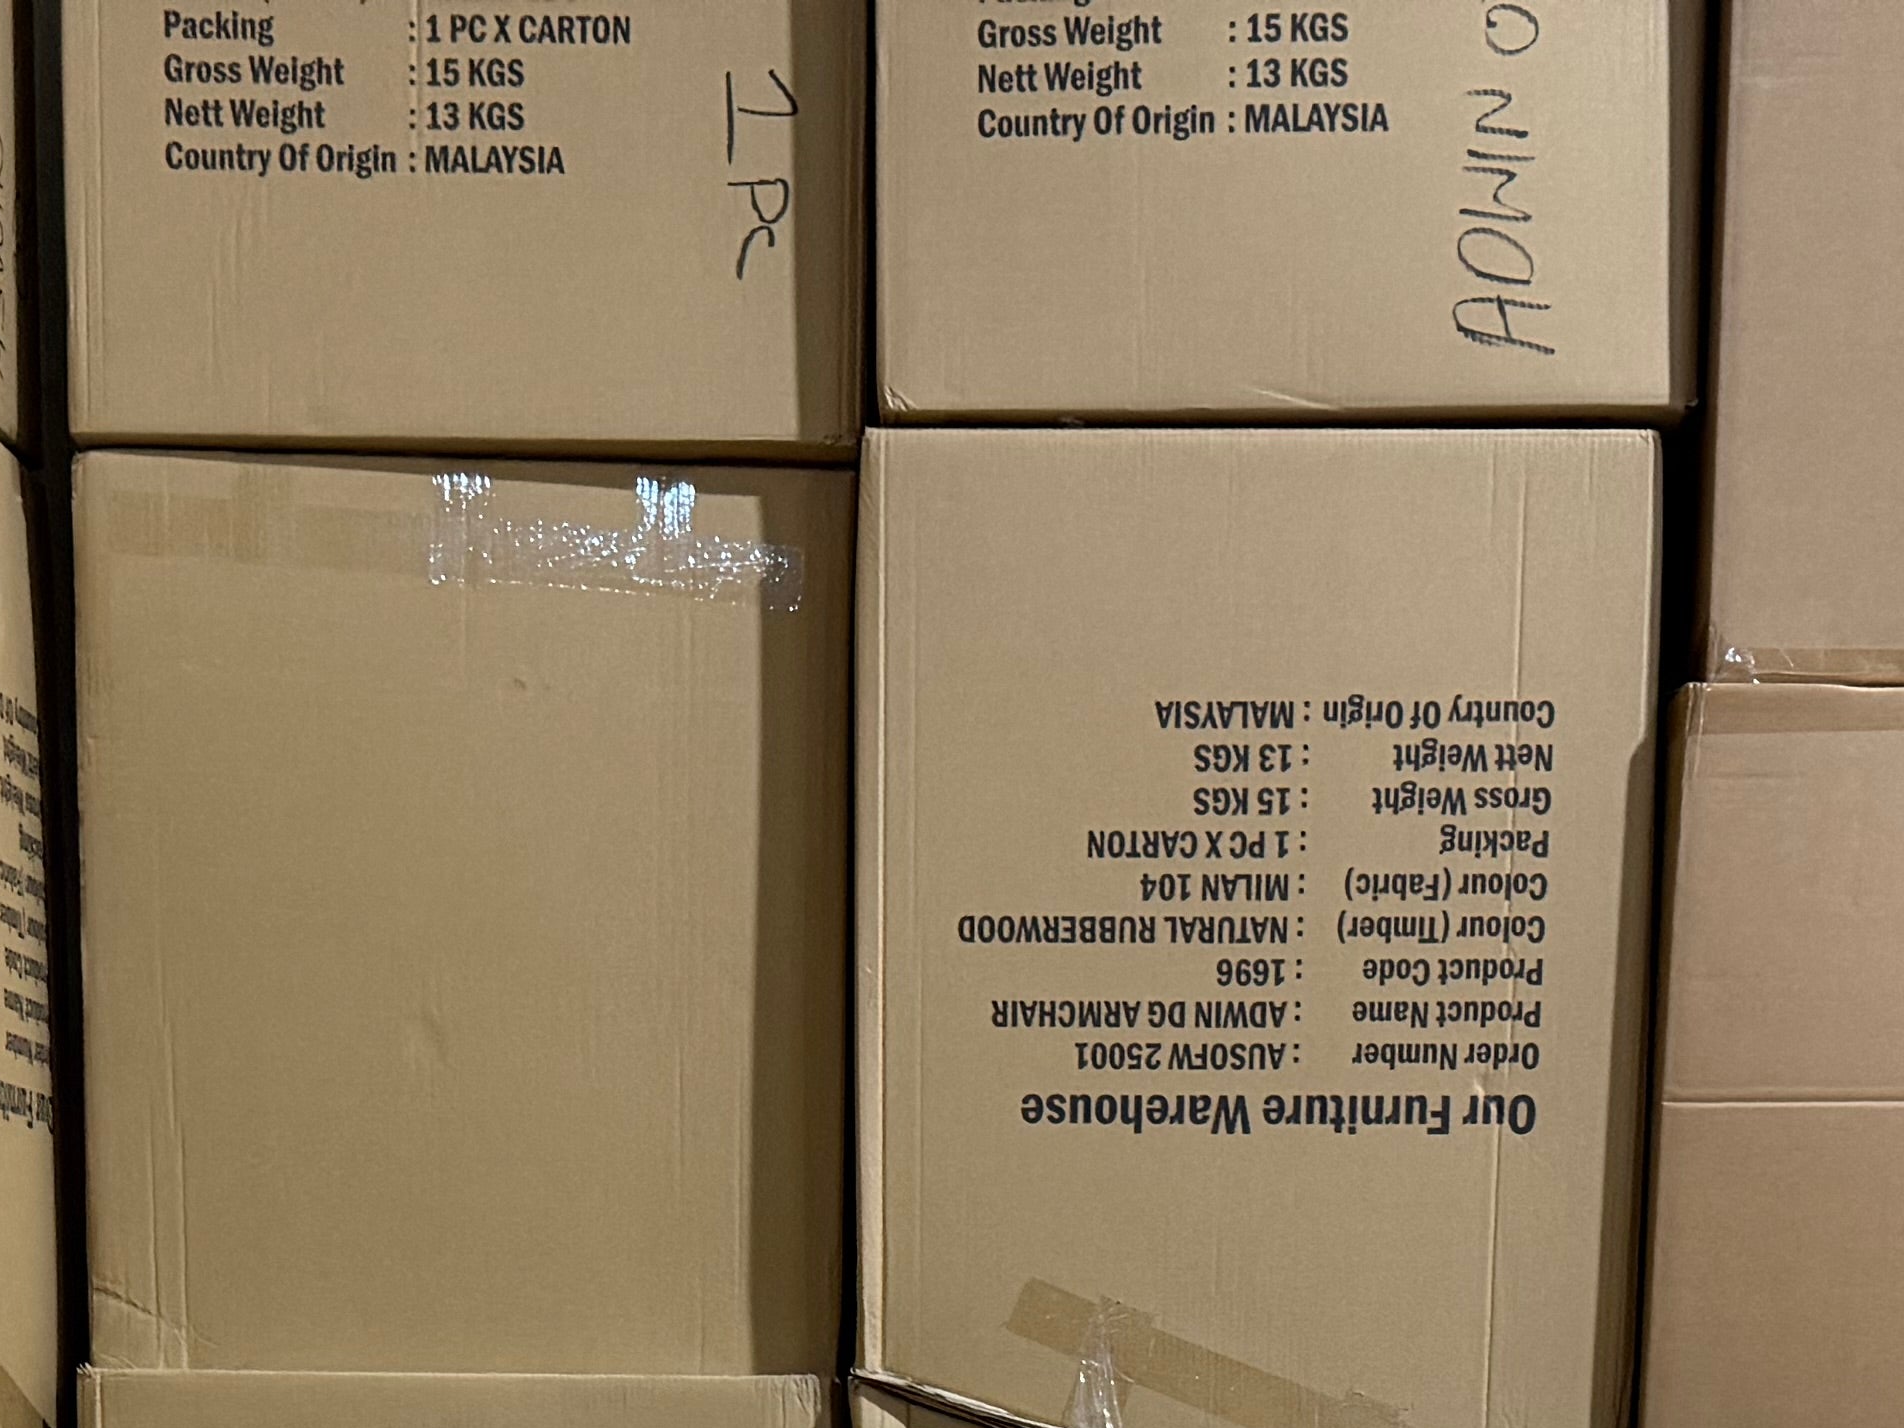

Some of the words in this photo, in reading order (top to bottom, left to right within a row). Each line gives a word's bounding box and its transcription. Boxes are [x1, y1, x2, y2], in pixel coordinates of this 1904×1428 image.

[162, 8, 275, 48] Packing
[425, 13, 442, 44] 1
[449, 12, 487, 44] PC
[492, 13, 512, 44] X
[517, 13, 631, 45] CARTON
[976, 18, 1058, 49] Gross
[1062, 13, 1162, 52] Weight
[1246, 11, 1282, 43] 15
[1289, 11, 1349, 43] KGS
[162, 52, 243, 84] Gross
[246, 54, 345, 92] Weight
[425, 56, 461, 88] 15
[467, 56, 525, 88] KGS
[977, 62, 1038, 94] Nett
[1042, 59, 1142, 98] Weight
[1245, 56, 1281, 89] 13
[1289, 56, 1348, 88] KGS
[163, 96, 224, 128] Nett
[227, 97, 326, 136] Weight
[425, 100, 460, 131] 13
[467, 100, 525, 131] KGS
[976, 106, 1087, 143] Country
[1092, 103, 1126, 136] Of
[1130, 103, 1215, 141] Origin
[1243, 101, 1389, 134] MALAYSIA
[164, 139, 272, 178] Country
[277, 141, 310, 172] Of
[314, 142, 397, 180] Origin
[424, 143, 565, 175] MALAYSIA
[1153, 699, 1294, 730] MALAYSIA
[1322, 692, 1404, 729] Origin
[1408, 699, 1441, 730] Of
[1446, 692, 1555, 729] Country
[1192, 743, 1250, 773] KGS
[1258, 742, 1292, 773] 13
[1392, 736, 1489, 773] Weight
[1493, 742, 1553, 772] Nett
[1192, 786, 1249, 816] KGS
[1256, 786, 1291, 816] 15
[1370, 779, 1467, 816] Weight
[1473, 784, 1552, 816] Gross
[1086, 829, 1198, 859] CARTON
[1204, 829, 1224, 859] X
[1228, 829, 1265, 859] PC
[1273, 829, 1290, 859] 1
[1438, 823, 1549, 861] Packing
[1139, 872, 1192, 902] 104
[1200, 872, 1289, 902] MILAN
[1343, 865, 1452, 902] (Fabric)
[1456, 871, 1548, 903] Colour
[956, 914, 1156, 944] RUBBERWOOD
[1162, 915, 1288, 945] NATURAL
[1336, 908, 1450, 945] (Timber)
[1455, 914, 1545, 945] Colour
[1215, 957, 1286, 987] 1696
[1361, 957, 1431, 987] Code
[1436, 956, 1543, 987] Product
[990, 999, 1141, 1029] ARMCHAIR
[1147, 1000, 1186, 1029] DG
[1193, 999, 1288, 1029] ADWIN
[1351, 1000, 1429, 1029] Name
[1434, 999, 1541, 1032] Product
[1073, 1041, 1162, 1071] 25001
[1166, 1041, 1287, 1071] AUSOFW
[1351, 1041, 1458, 1071] Number
[1462, 1041, 1540, 1071] Order
[1019, 1092, 1251, 1135] Warehouse
[1261, 1093, 1451, 1136] Furniture
[1461, 1093, 1536, 1136] Our
